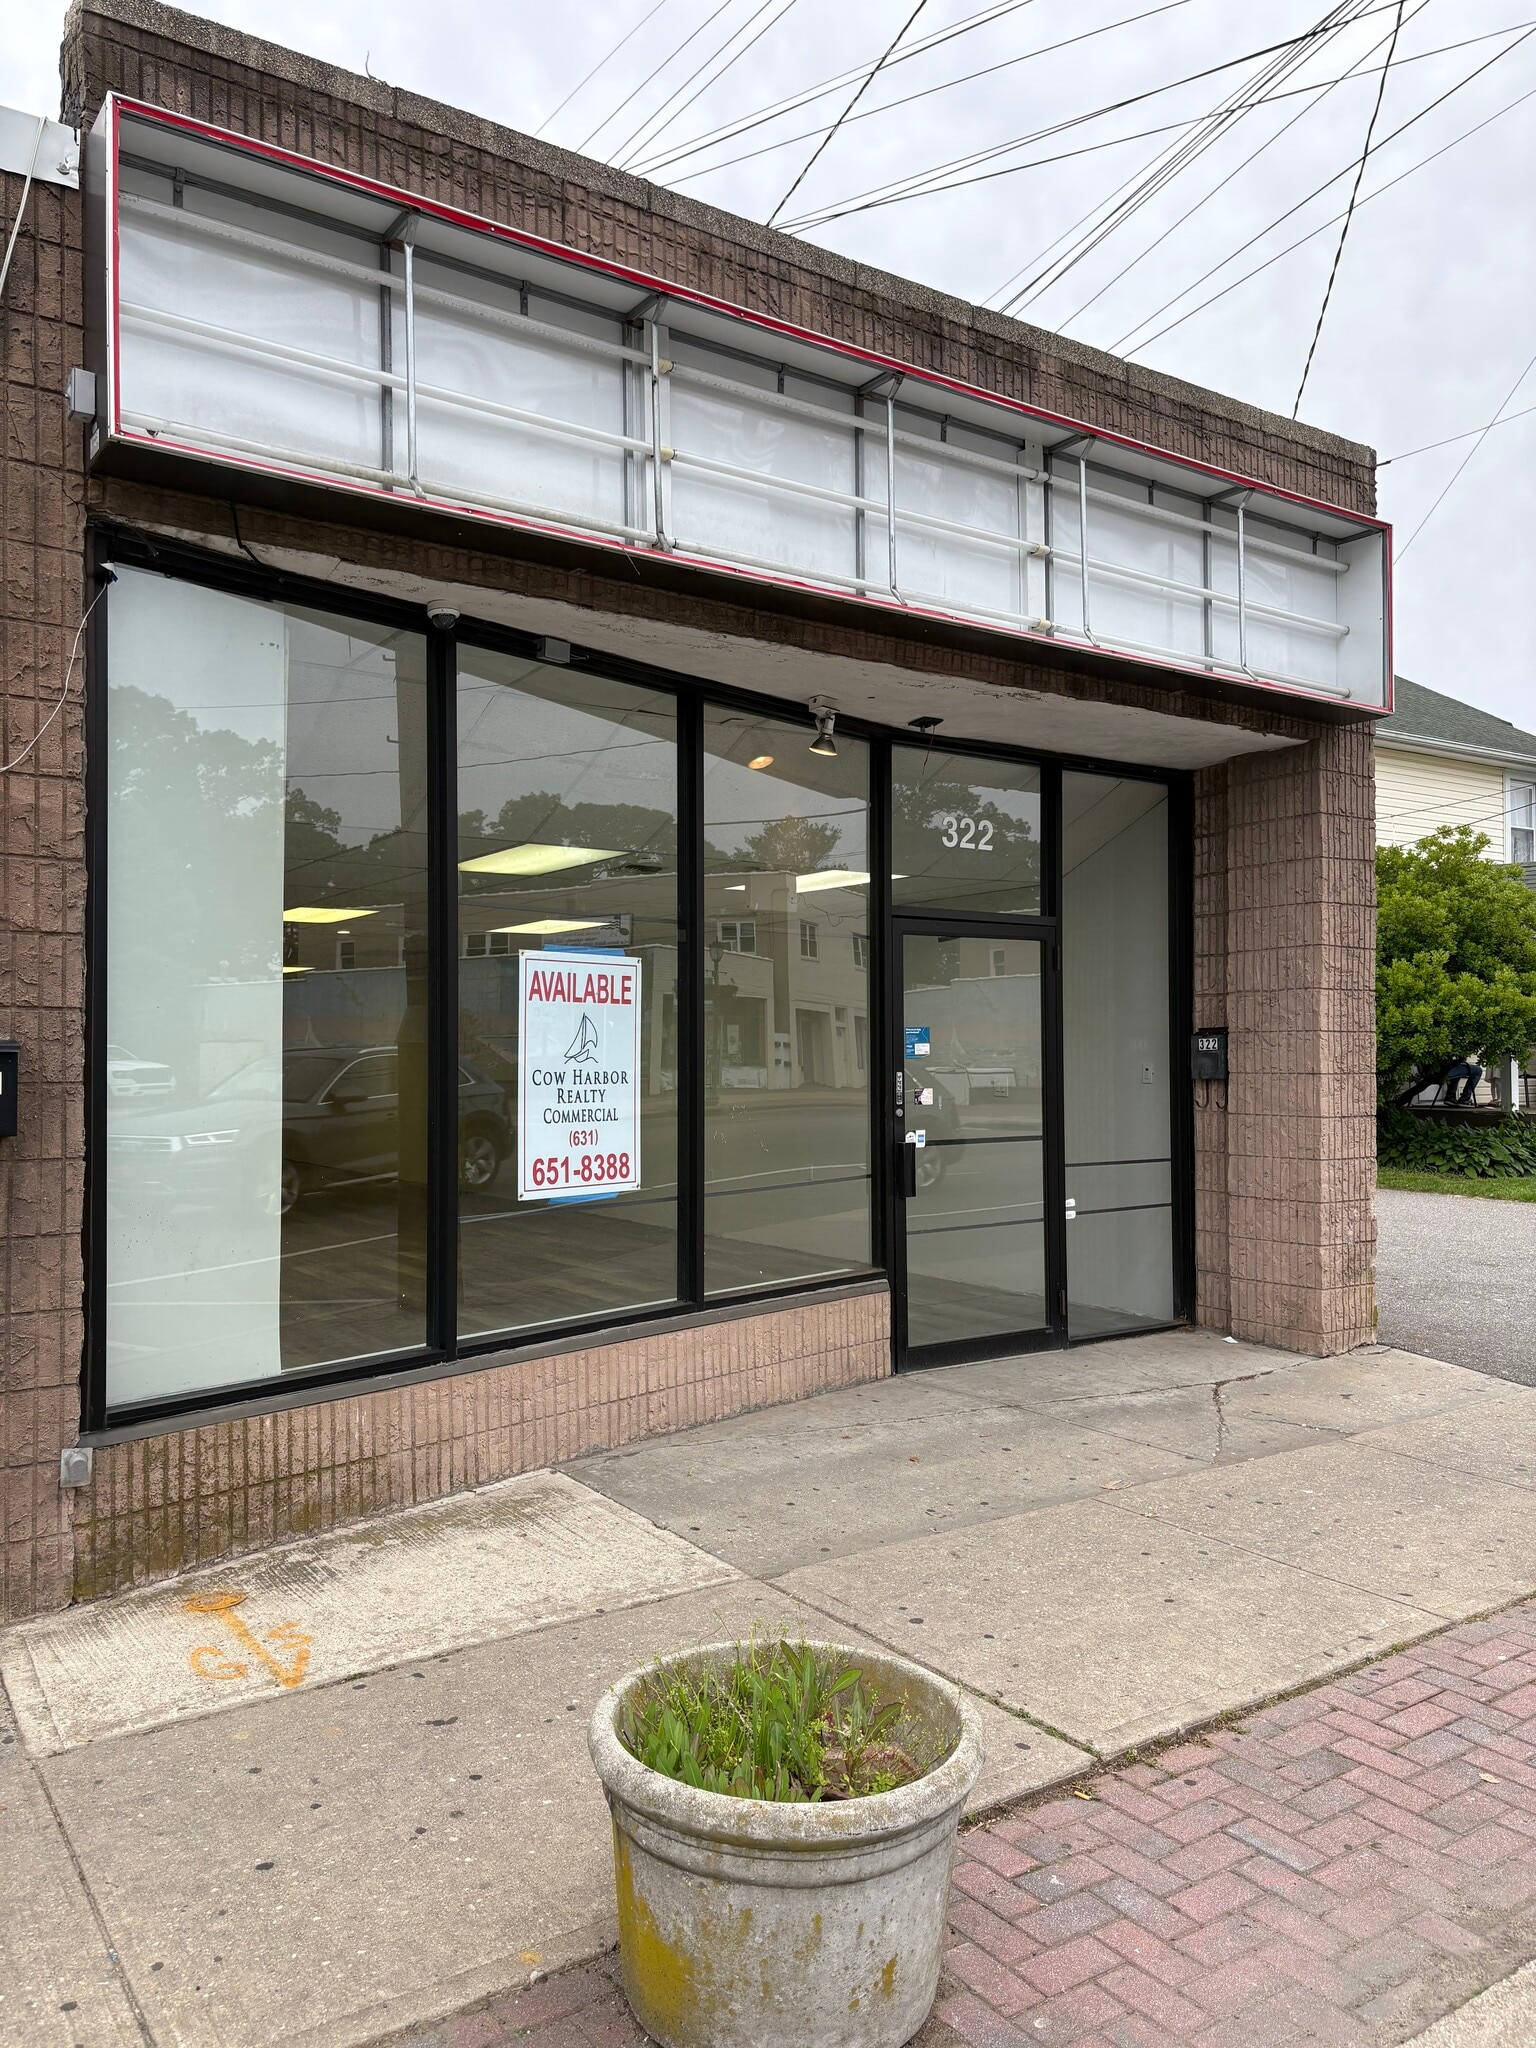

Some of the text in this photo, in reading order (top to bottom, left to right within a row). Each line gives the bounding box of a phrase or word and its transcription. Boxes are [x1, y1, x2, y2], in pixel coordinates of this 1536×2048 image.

[941, 816, 994, 851] 322
[528, 970, 632, 1005] AVAILABLE
[1199, 1038, 1218, 1050] 322
[569, 1129, 598, 1147] (631)
[532, 1152, 630, 1186] 651-8388
